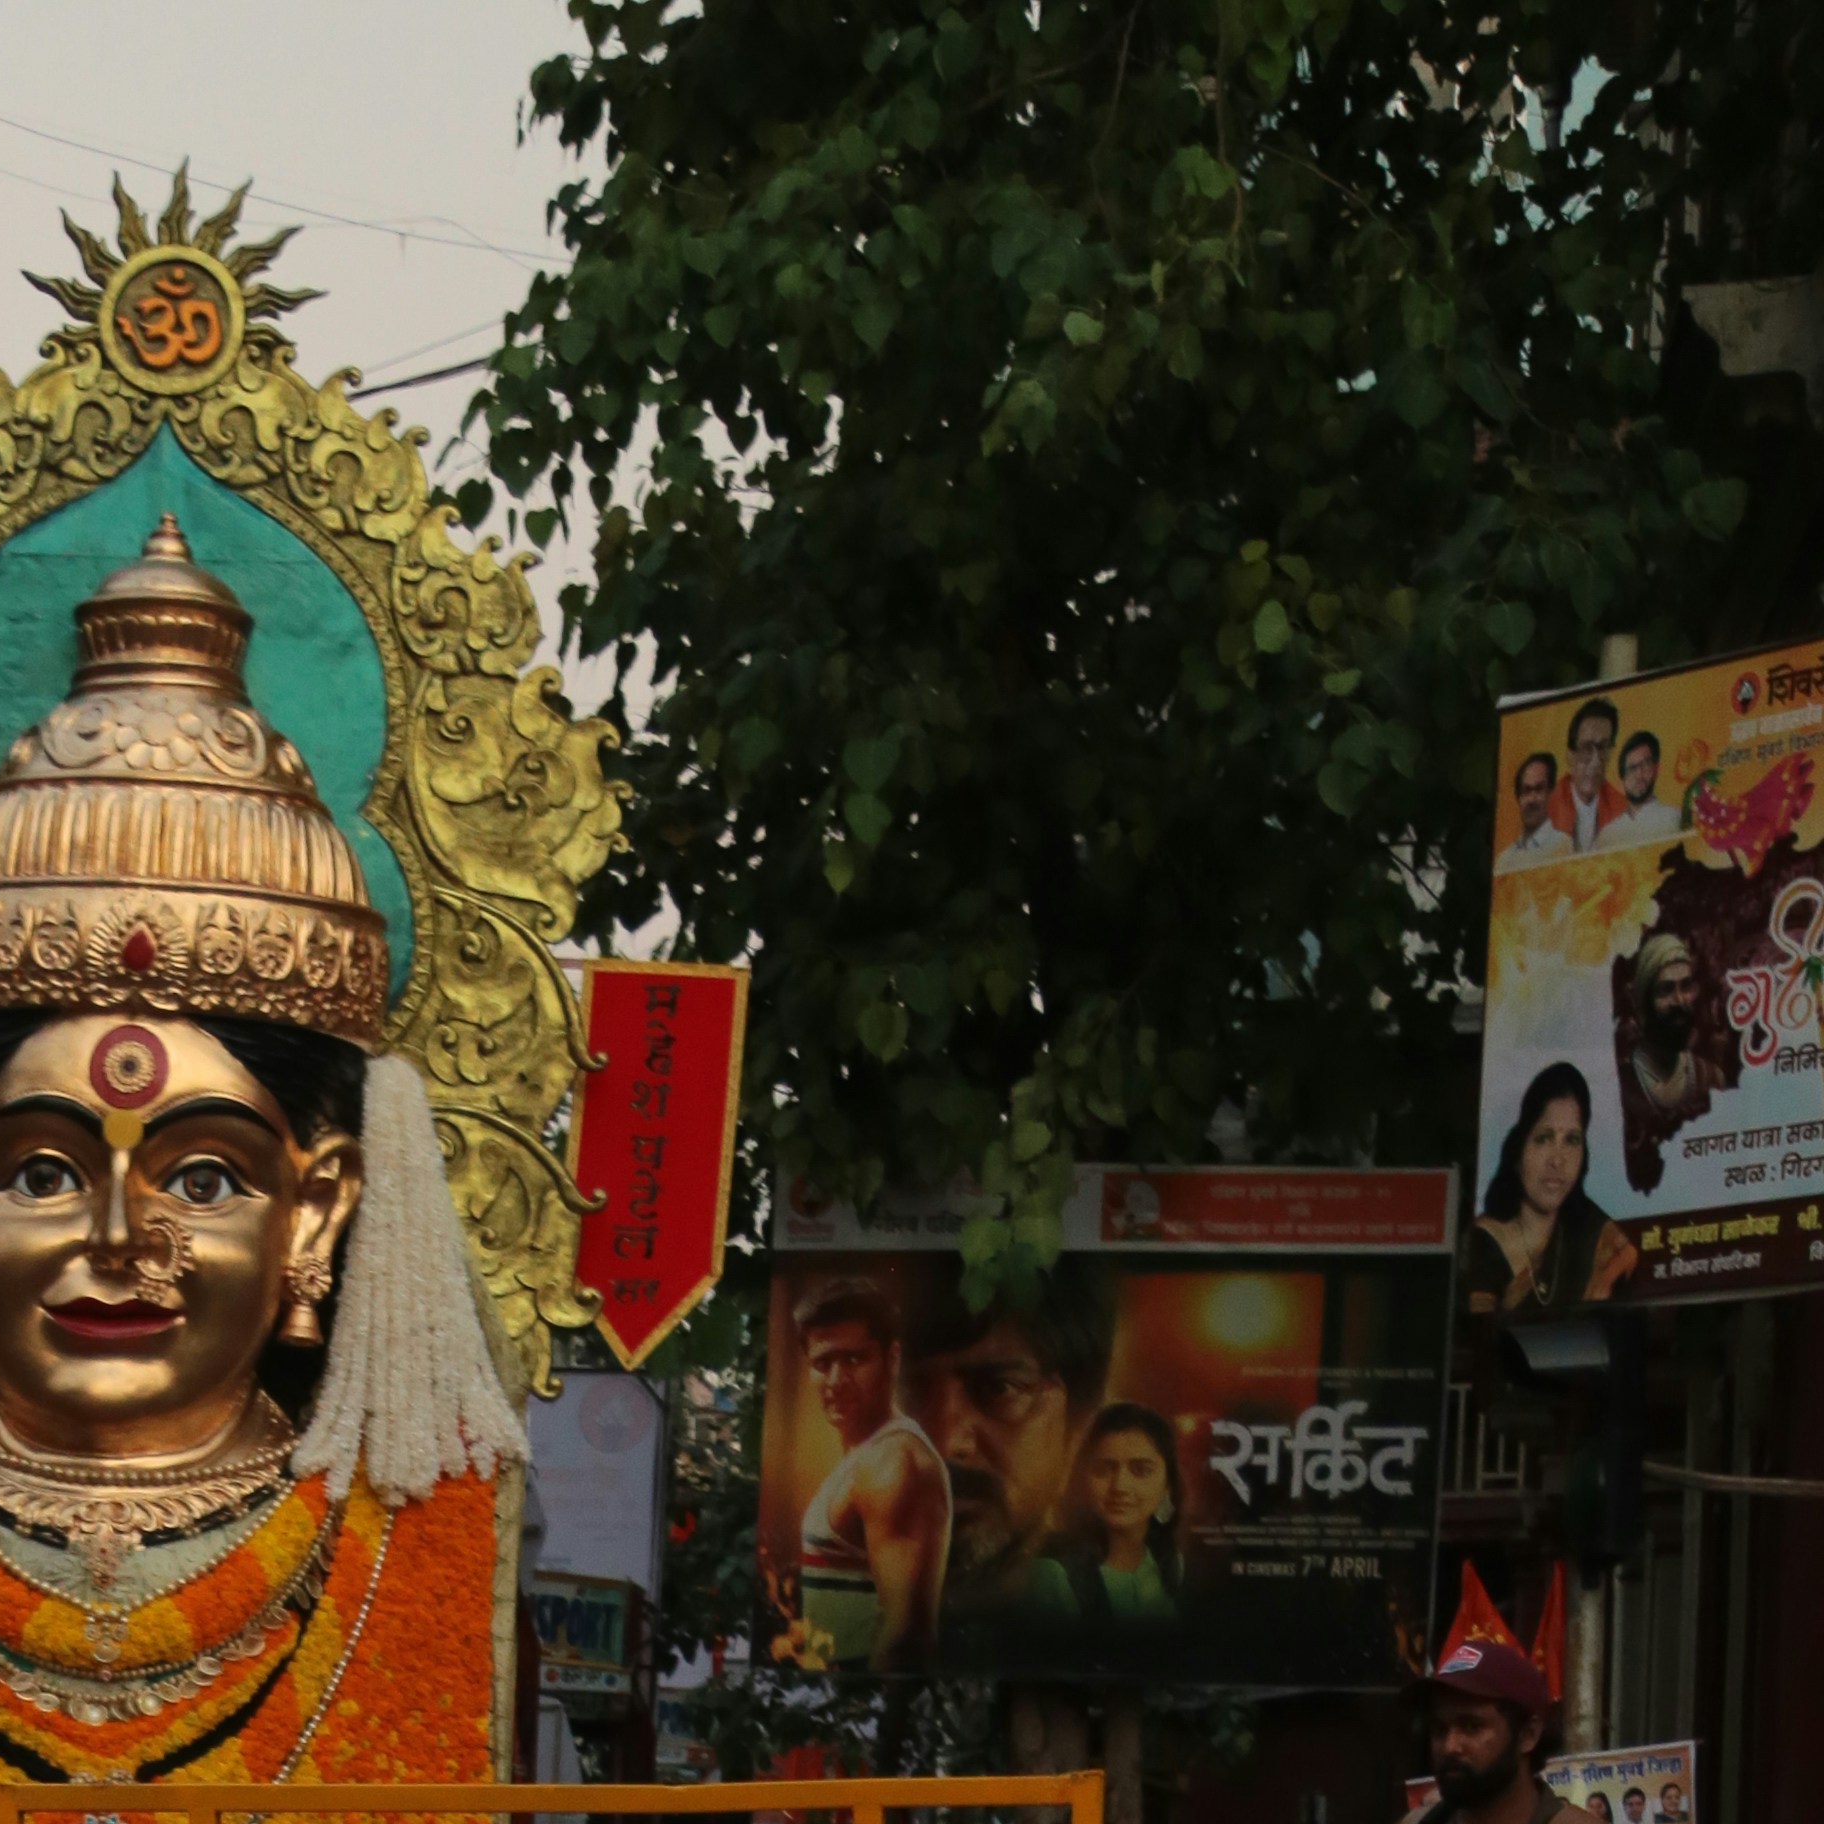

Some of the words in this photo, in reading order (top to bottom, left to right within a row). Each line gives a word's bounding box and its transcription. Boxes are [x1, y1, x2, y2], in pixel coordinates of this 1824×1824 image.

[1683, 1131, 1736, 1159] स्वागत
[1742, 1126, 1782, 1150] यात्रा
[1209, 1398, 1430, 1507] सर्किट
[1330, 1555, 1384, 1579] APRIL
